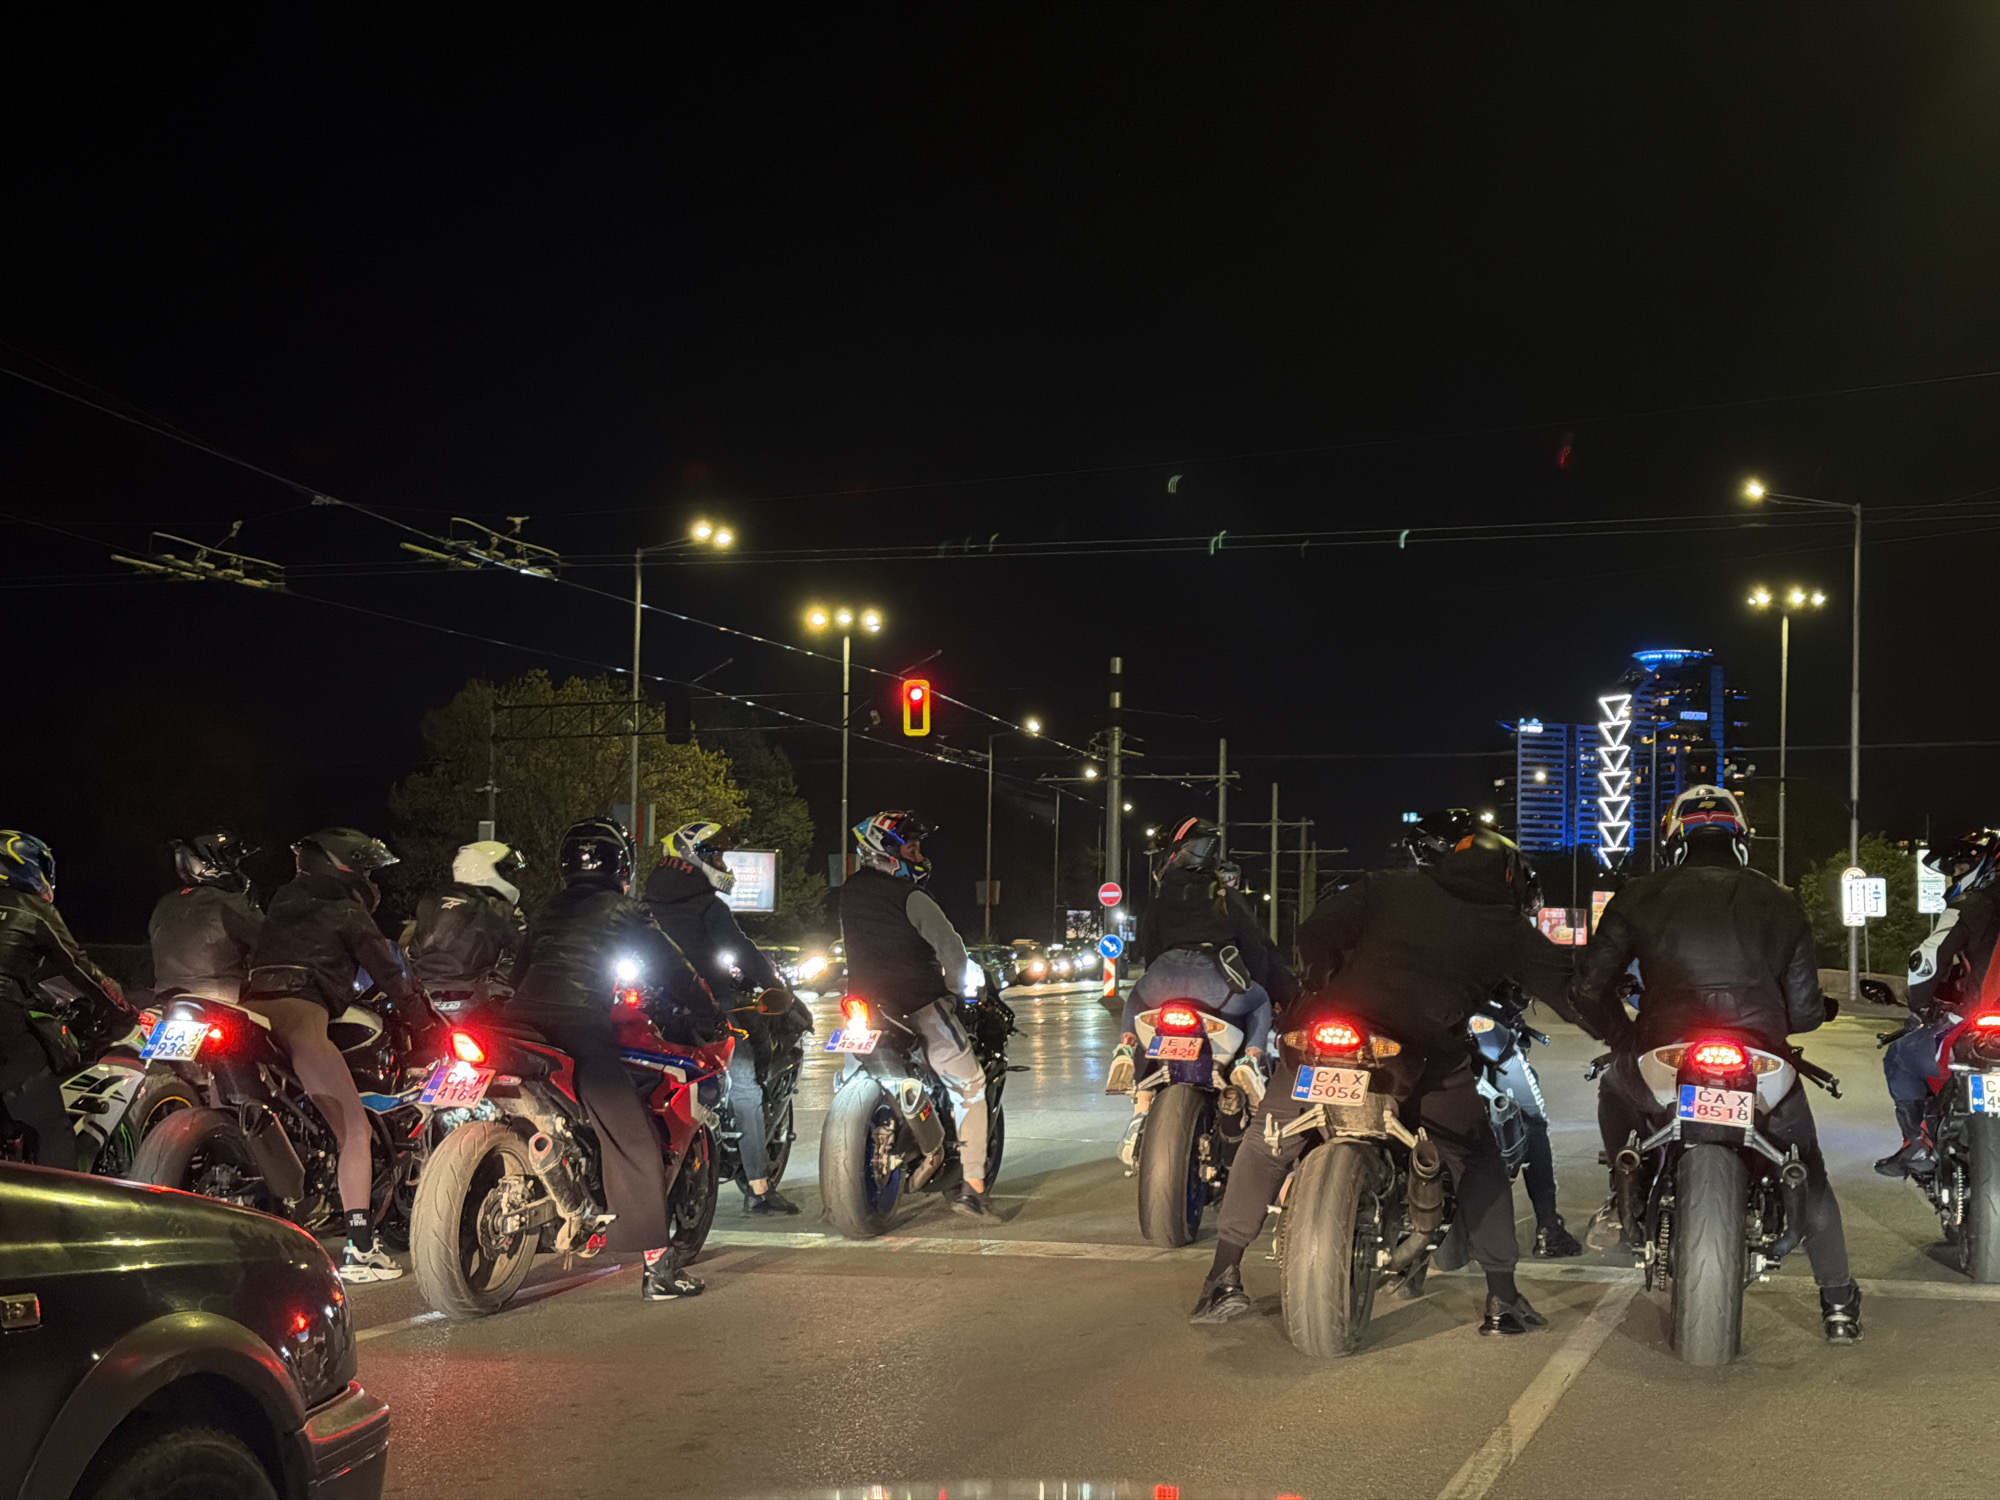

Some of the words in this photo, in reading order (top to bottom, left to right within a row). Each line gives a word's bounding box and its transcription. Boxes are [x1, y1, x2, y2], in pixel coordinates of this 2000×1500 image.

[164, 1027, 185, 1041] CA
[155, 1042, 197, 1057] 9363
[1160, 1047, 1196, 1056] 6420
[446, 1072, 469, 1088] CA
[1316, 1071, 1342, 1084] CA
[1352, 1073, 1365, 1086] X
[437, 1087, 480, 1102] 4164
[1311, 1084, 1361, 1100] 5056
[1698, 1091, 1726, 1105] CA
[1737, 1095, 1749, 1107] X
[1696, 1104, 1749, 1121] 8518
